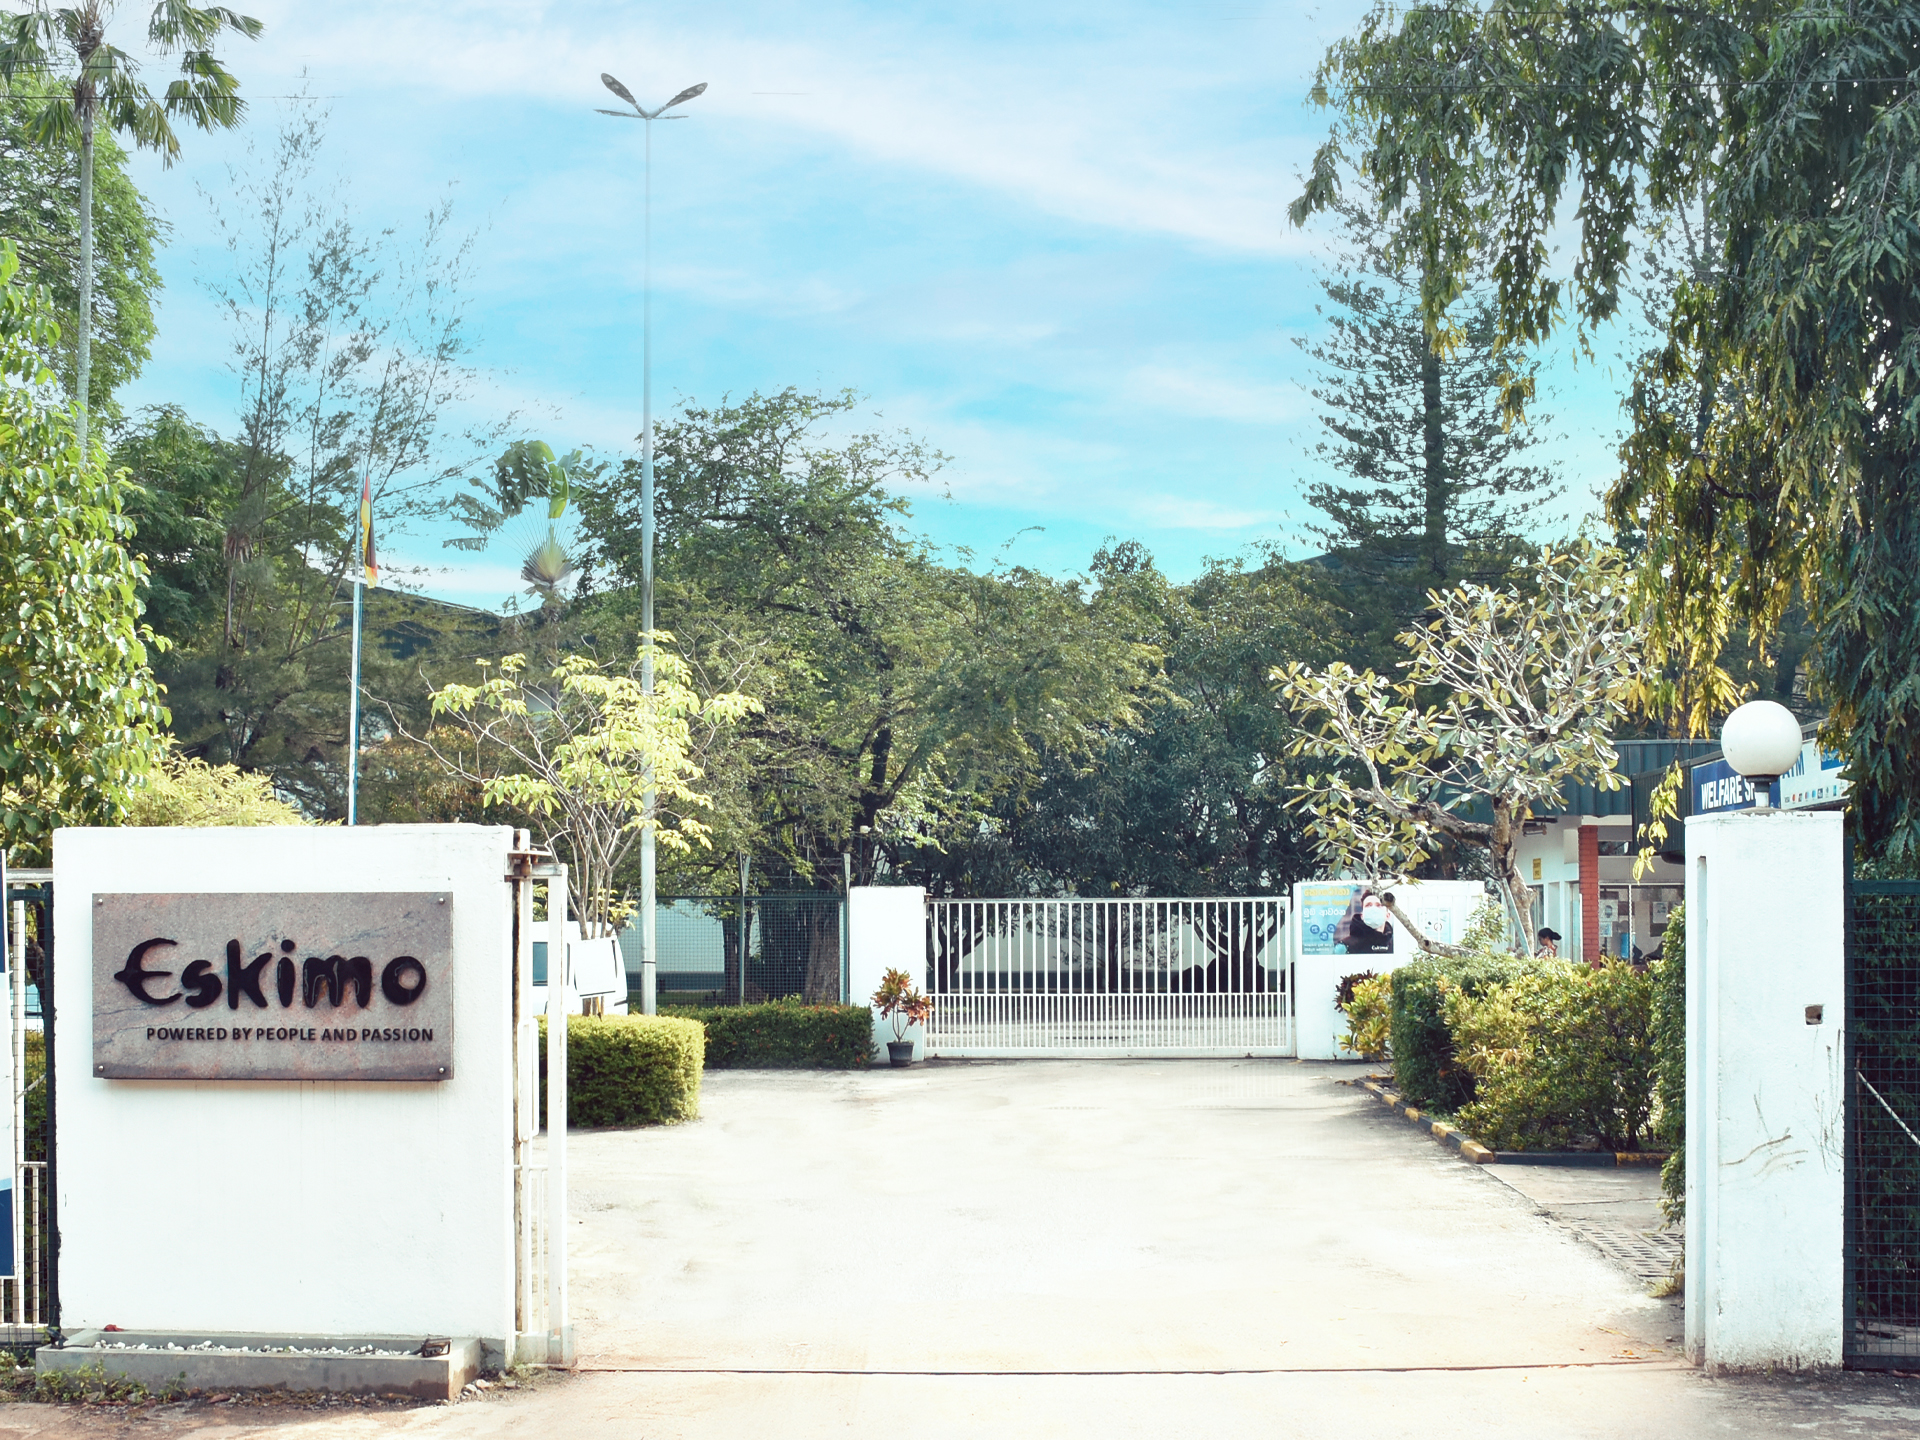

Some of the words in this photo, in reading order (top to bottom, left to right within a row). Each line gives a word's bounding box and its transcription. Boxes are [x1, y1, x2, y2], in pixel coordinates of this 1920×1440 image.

[1701, 775, 1743, 810] WELFARE
[114, 937, 427, 1010] Eskimo
[146, 1027, 228, 1042] POWERED
[232, 1027, 252, 1042] BY
[256, 1027, 316, 1042] PEOPLE
[321, 1027, 357, 1042] AND
[361, 1027, 434, 1042] PASSION
